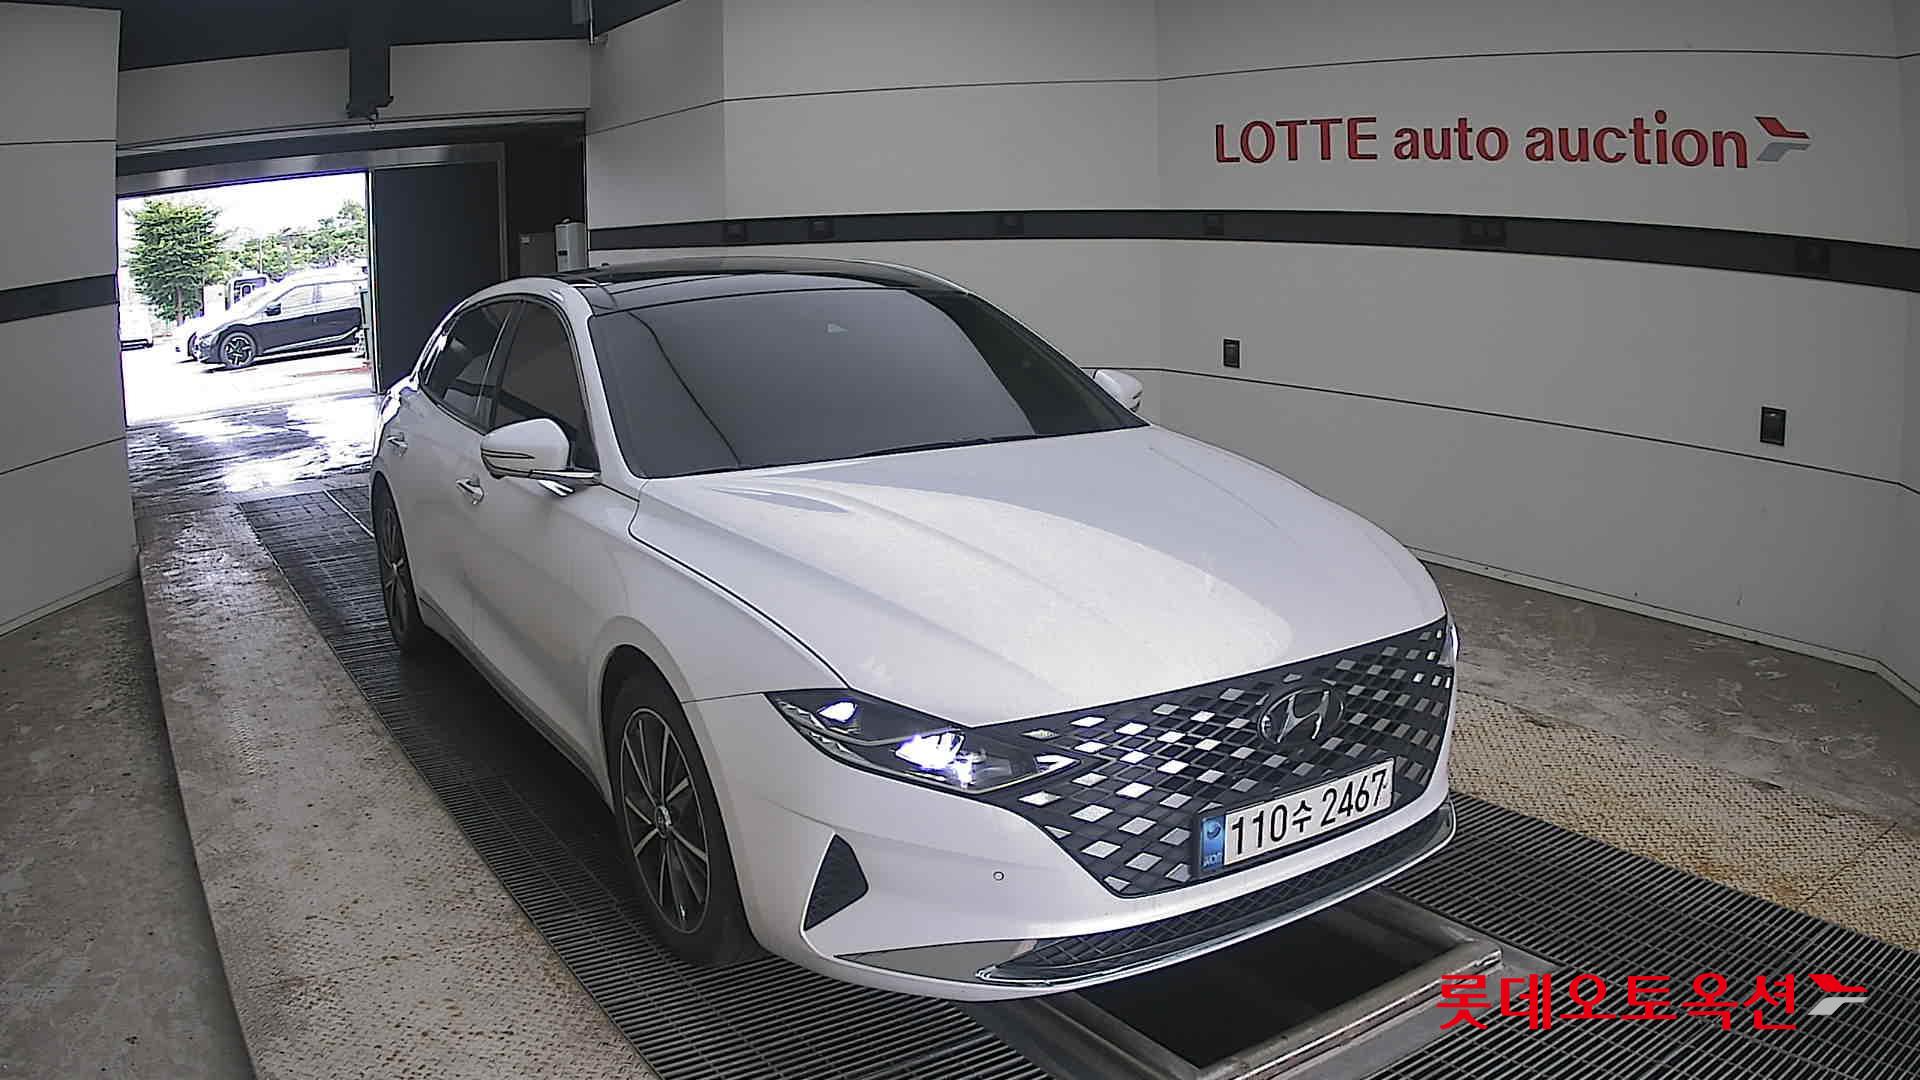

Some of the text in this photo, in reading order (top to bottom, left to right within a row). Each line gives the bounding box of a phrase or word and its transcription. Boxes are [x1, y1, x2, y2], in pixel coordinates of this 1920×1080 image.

[1215, 110, 1748, 168] LOTTE auto auction
[1231, 768, 1388, 855] 110수 2467
